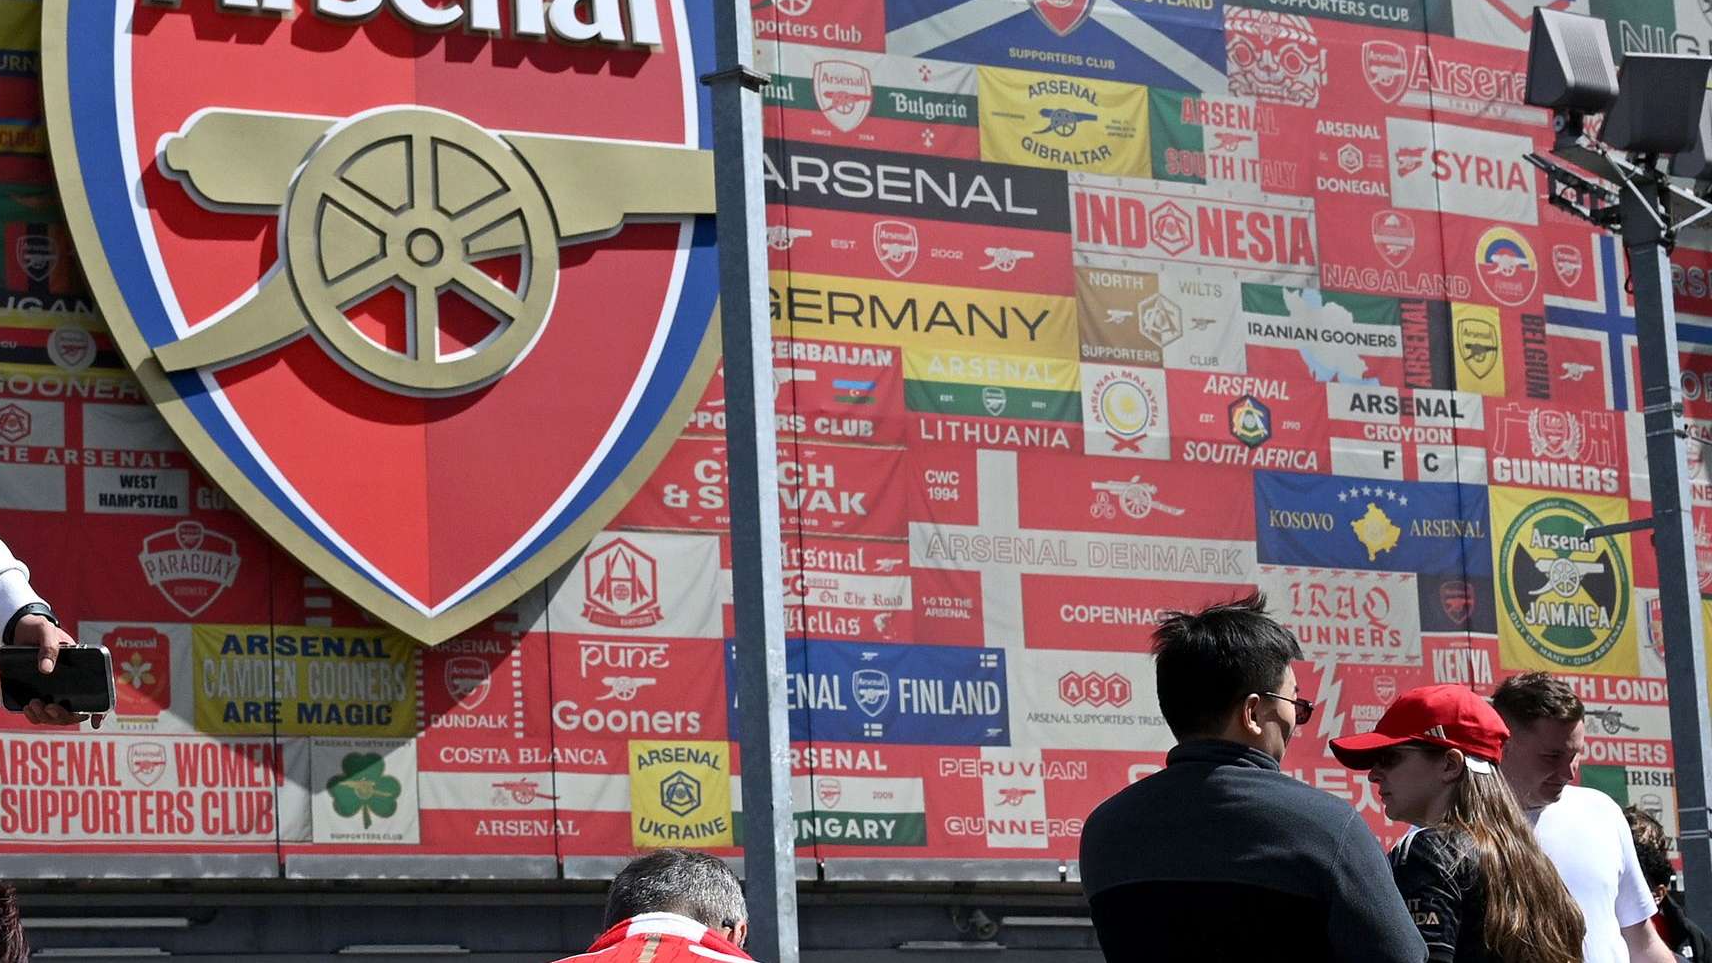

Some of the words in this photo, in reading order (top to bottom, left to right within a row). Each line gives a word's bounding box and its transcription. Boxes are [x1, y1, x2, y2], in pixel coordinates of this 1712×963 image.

[1370, 2, 1410, 23] CLUB
[822, 22, 863, 45] Club
[1008, 47, 1083, 67] SUPPORTERS
[1085, 54, 1116, 70] CLUB
[1028, 79, 1100, 106] ARSENAL
[1315, 118, 1382, 140] ARSENAL
[1021, 135, 1113, 165] GIBRALTAR
[1316, 177, 1389, 198] DONEGAL
[1088, 271, 1144, 291] NORTH
[1178, 279, 1223, 299] WILTS
[1247, 321, 1319, 343] IRANIAN
[1321, 329, 1398, 349] GOONERS
[1081, 343, 1160, 363] SUPPORTERS
[1189, 354, 1220, 368] CLUB
[1204, 375, 1291, 402] ARSENAL
[1349, 392, 1465, 419] ARSENAL
[827, 416, 875, 437] CLUB
[920, 418, 1070, 449] LITHUANIA
[1364, 423, 1453, 445] CROYDON
[44, 446, 172, 468] ARSENAL
[1183, 440, 1250, 465] SOUTH
[1253, 448, 1319, 472] AFRICA
[119, 474, 158, 490] WEST
[925, 470, 960, 486] CWC
[99, 491, 179, 510] HAMPSTEAD
[927, 485, 960, 502] 1994
[1268, 508, 1334, 532] KOSOVO
[1410, 518, 1486, 540] ARSENAL
[925, 605, 971, 620] ARSENAL
[115, 634, 158, 649] Arsenal
[220, 634, 392, 659] ARSENAL
[222, 702, 284, 724] ARE
[296, 700, 393, 726] MAGIC
[430, 713, 509, 730] DUNDALK
[552, 701, 701, 734] Gooners
[174, 743, 285, 788] WOMEN
[439, 746, 513, 765] COSTA
[518, 747, 608, 766] BLANCA
[637, 748, 722, 772] ARSENAL
[939, 757, 1088, 781] PERUVIAN
[1, 790, 197, 836] SUPPORTERS
[201, 793, 275, 837] CLUB
[475, 820, 580, 838] ARSENAL
[638, 817, 728, 842] UKRAINE
